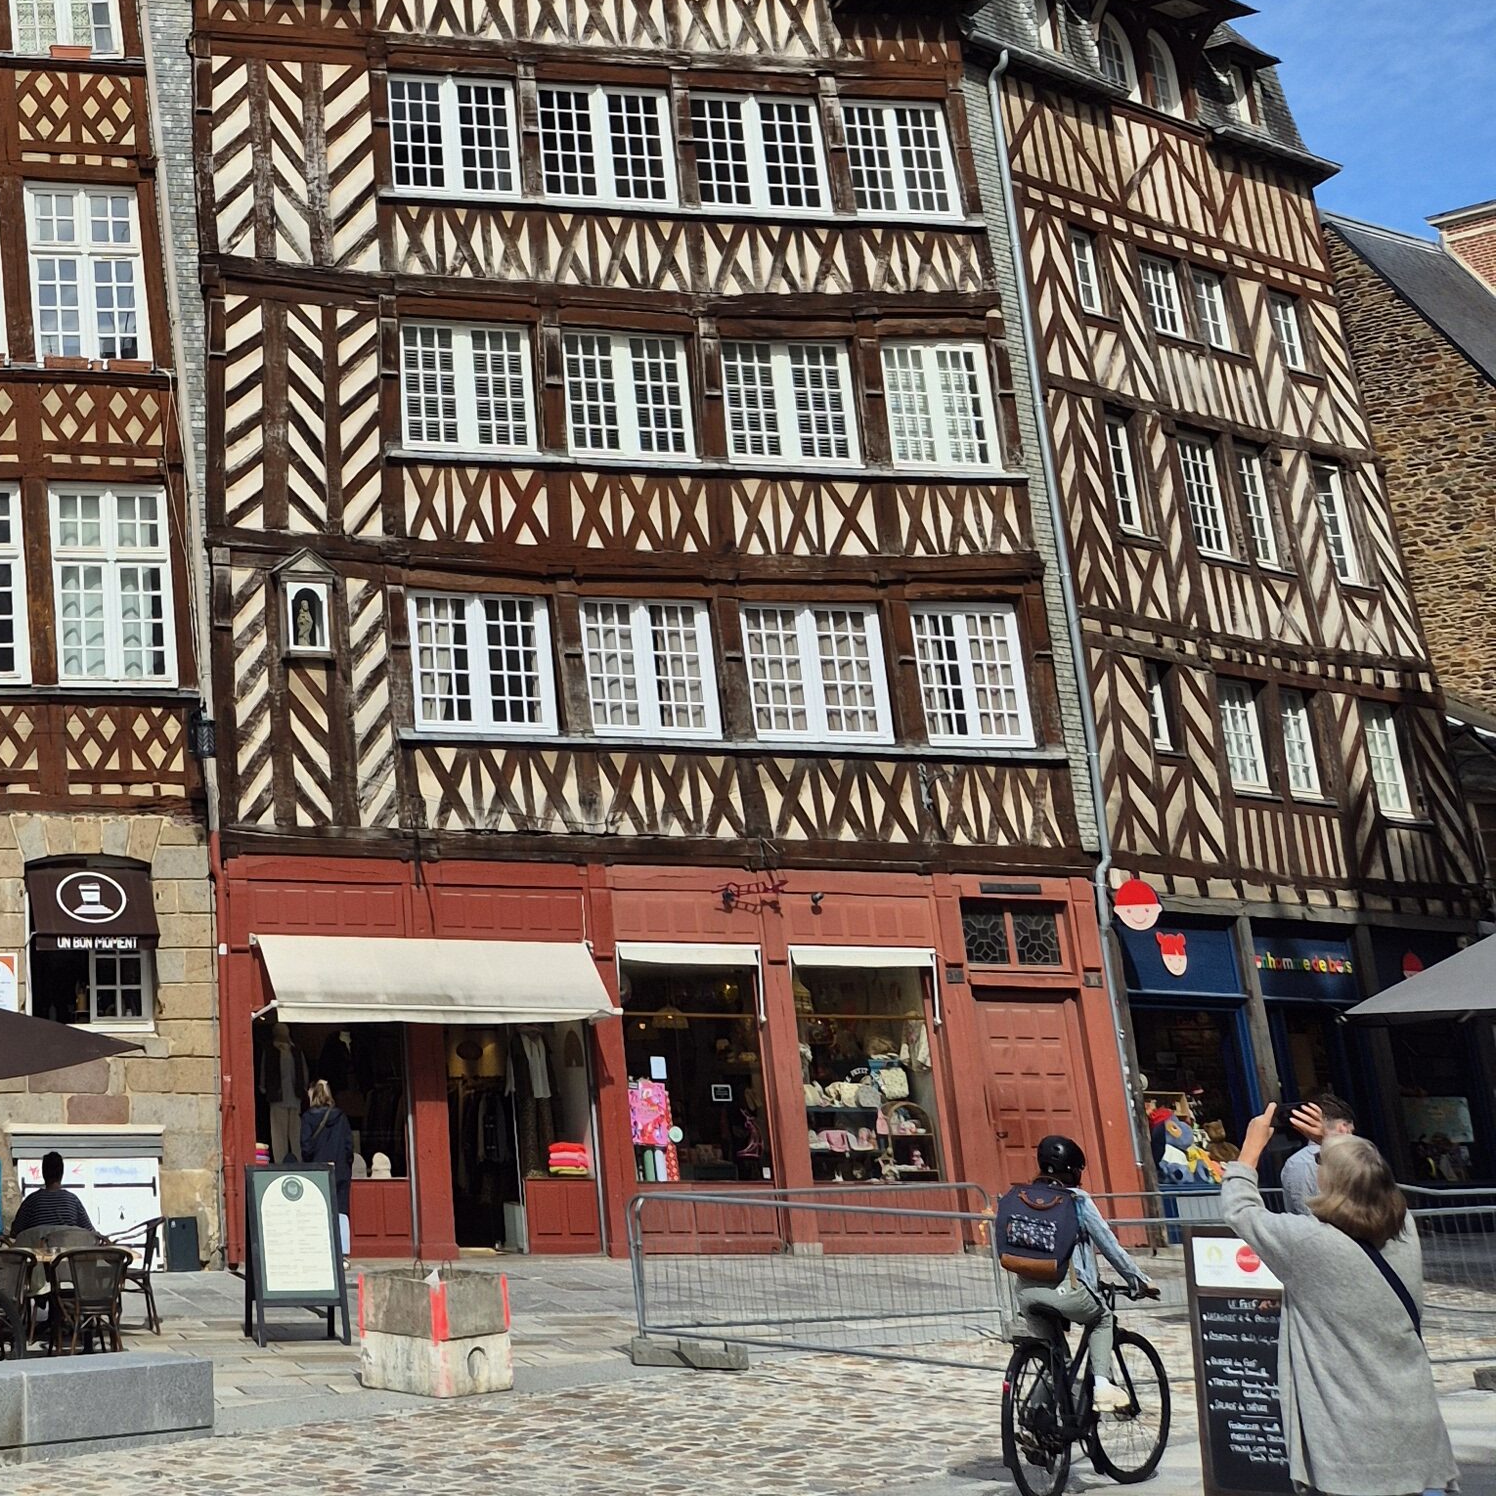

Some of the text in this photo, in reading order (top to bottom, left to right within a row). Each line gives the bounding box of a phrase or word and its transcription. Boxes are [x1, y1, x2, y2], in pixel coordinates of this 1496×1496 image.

[57, 937, 138, 949] UN BON MOMENT
